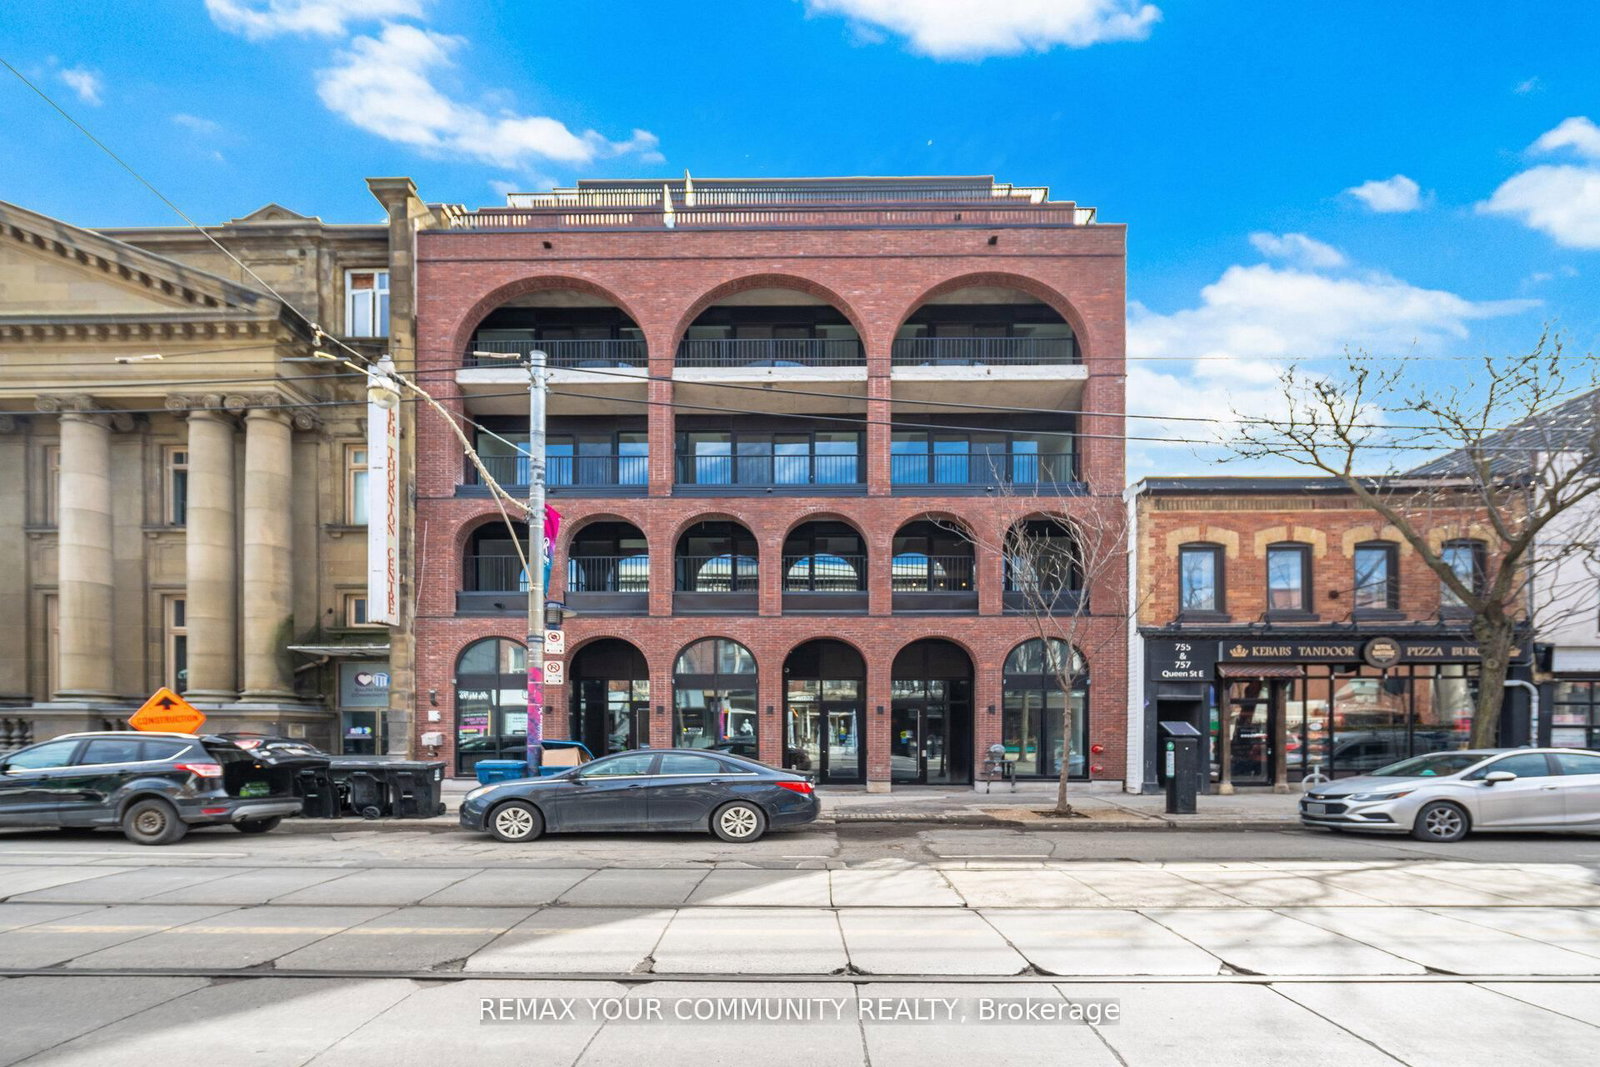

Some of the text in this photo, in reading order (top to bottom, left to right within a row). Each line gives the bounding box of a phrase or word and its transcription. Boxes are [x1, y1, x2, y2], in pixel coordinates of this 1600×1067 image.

[387, 547, 396, 616] CENTRE
[1175, 643, 1191, 651] 755
[1252, 646, 1292, 656] KEBABS
[1298, 646, 1355, 656] TANDOOR
[1406, 646, 1444, 657] PIZZA
[1179, 652, 1187, 660] &
[1174, 661, 1191, 669] 757
[1161, 670, 1188, 678] Queen
[137, 715, 199, 725] CONSTRUCTION
